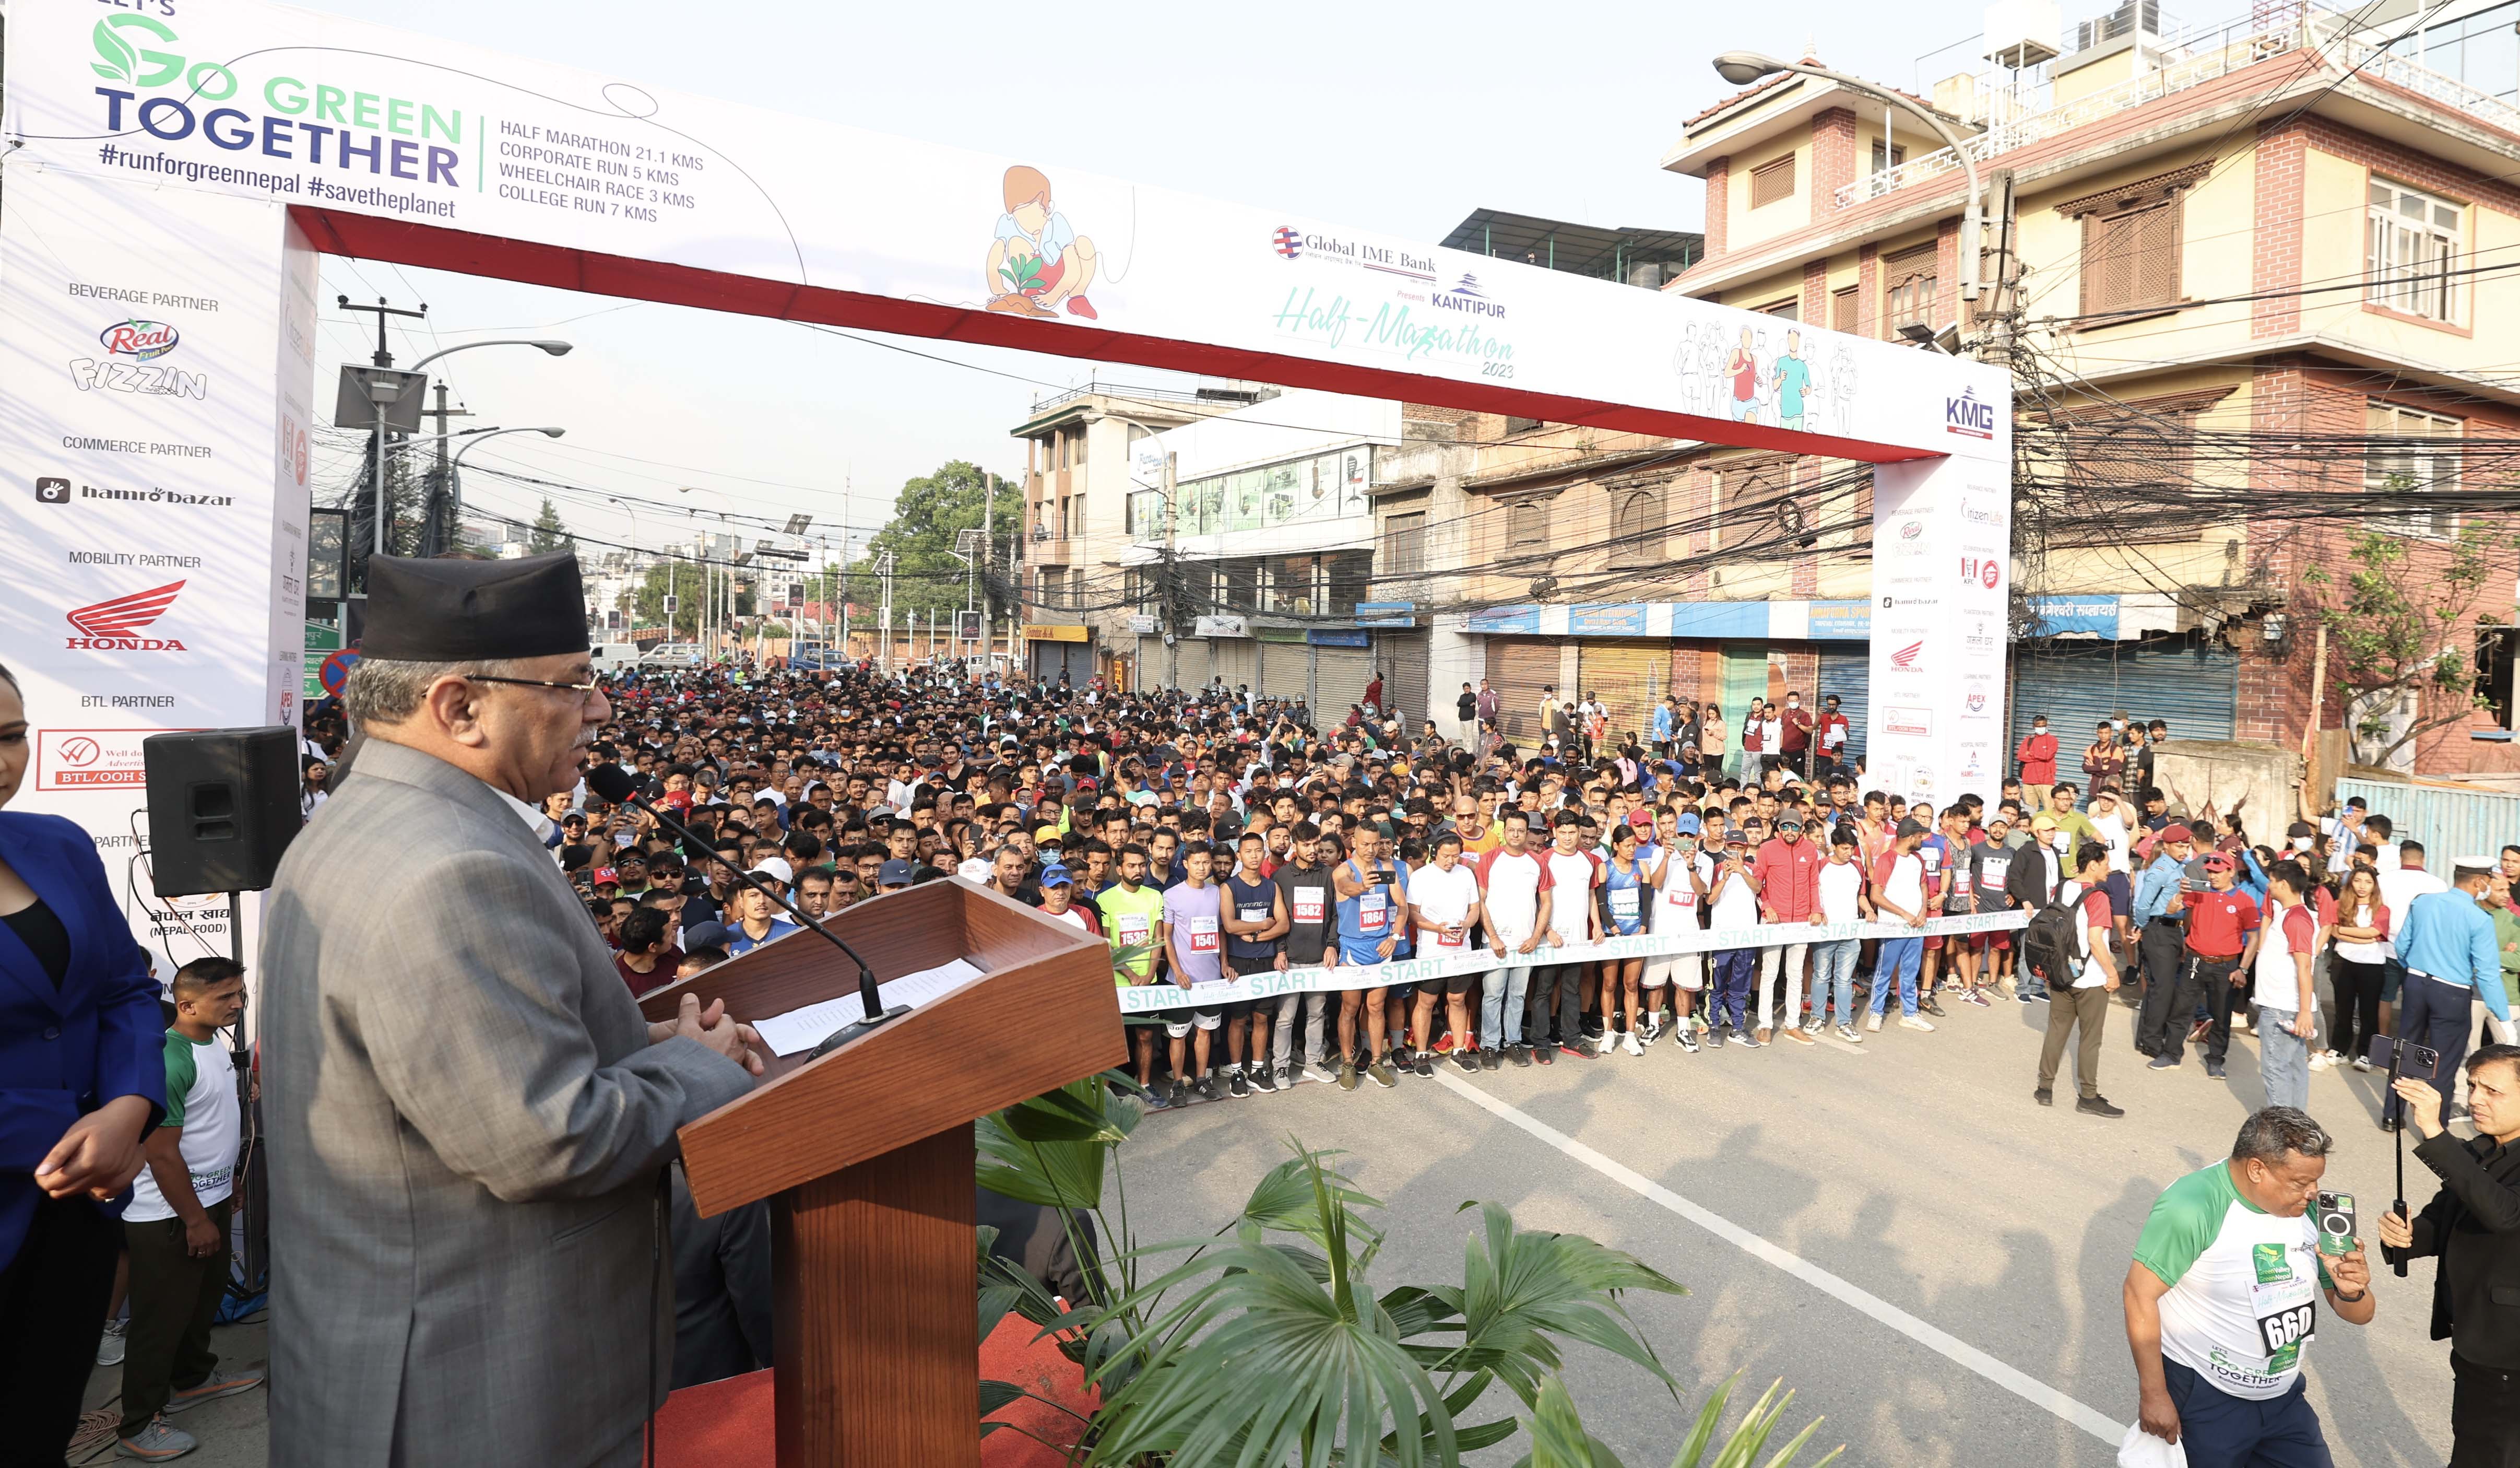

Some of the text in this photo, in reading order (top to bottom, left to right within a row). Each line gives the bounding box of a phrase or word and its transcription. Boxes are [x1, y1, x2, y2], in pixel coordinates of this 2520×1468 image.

[264, 76, 461, 144] GREEN
[96, 87, 459, 187] TOGETHER
[500, 120, 703, 171] HALF MARATHON 21.1 KMS
[500, 142, 679, 186] CORPORATE RUN 5 KMS
[99, 144, 456, 218] #runforgreennepal #savetheplanet
[500, 162, 695, 209] WHEELCHAIR RACE 3 KMS
[499, 184, 657, 222] COLLEGE RUN 7 KMS
[1305, 234, 1436, 272] Global IME Bank
[69, 283, 219, 312] BEVERAGE PARTNER
[1397, 290, 1425, 302] Presents
[1433, 292, 1506, 319] KANTIPUR
[109, 325, 173, 355] Real
[138, 348, 161, 361] Fruit
[69, 358, 207, 401] FIZZIN
[1482, 361, 1514, 379] 2023
[1947, 397, 1993, 430] KMG
[63, 436, 212, 459] COMMERCE PARTNER
[1891, 507, 1934, 517] BEVERAGE PARTNER
[1961, 500, 1989, 522] Citizen
[1902, 522, 1922, 539] Real
[69, 551, 202, 569] MOBILITY PARTNER
[1809, 606, 1849, 619] ANNAPURNA
[66, 637, 188, 651] HONDA
[81, 695, 174, 708] BTL PARTNER
[1966, 692, 1987, 709] APEX
[62, 772, 134, 782] BTL/OOH
[94, 835, 151, 848] PARTNE
[1295, 903, 1322, 917] 1582
[1362, 910, 1385, 925] 1864
[150, 923, 227, 938] (NEPAL FOOD)
[1820, 922, 1870, 939] START
[1966, 914, 1997, 930] START
[1194, 934, 1216, 947] 1541
[1610, 936, 1671, 956] START
[1718, 927, 1774, 947] START
[1380, 958, 1446, 983] START
[1250, 971, 1321, 995] START
[1127, 988, 1191, 1009] START
[192, 1170, 230, 1189] OGETHER
[206, 1163, 232, 1178] GREEN
[2265, 1306, 2312, 1351] 660
[2211, 1345, 2228, 1355] LET'S
[2210, 1363, 2283, 1384] TOGETHER
